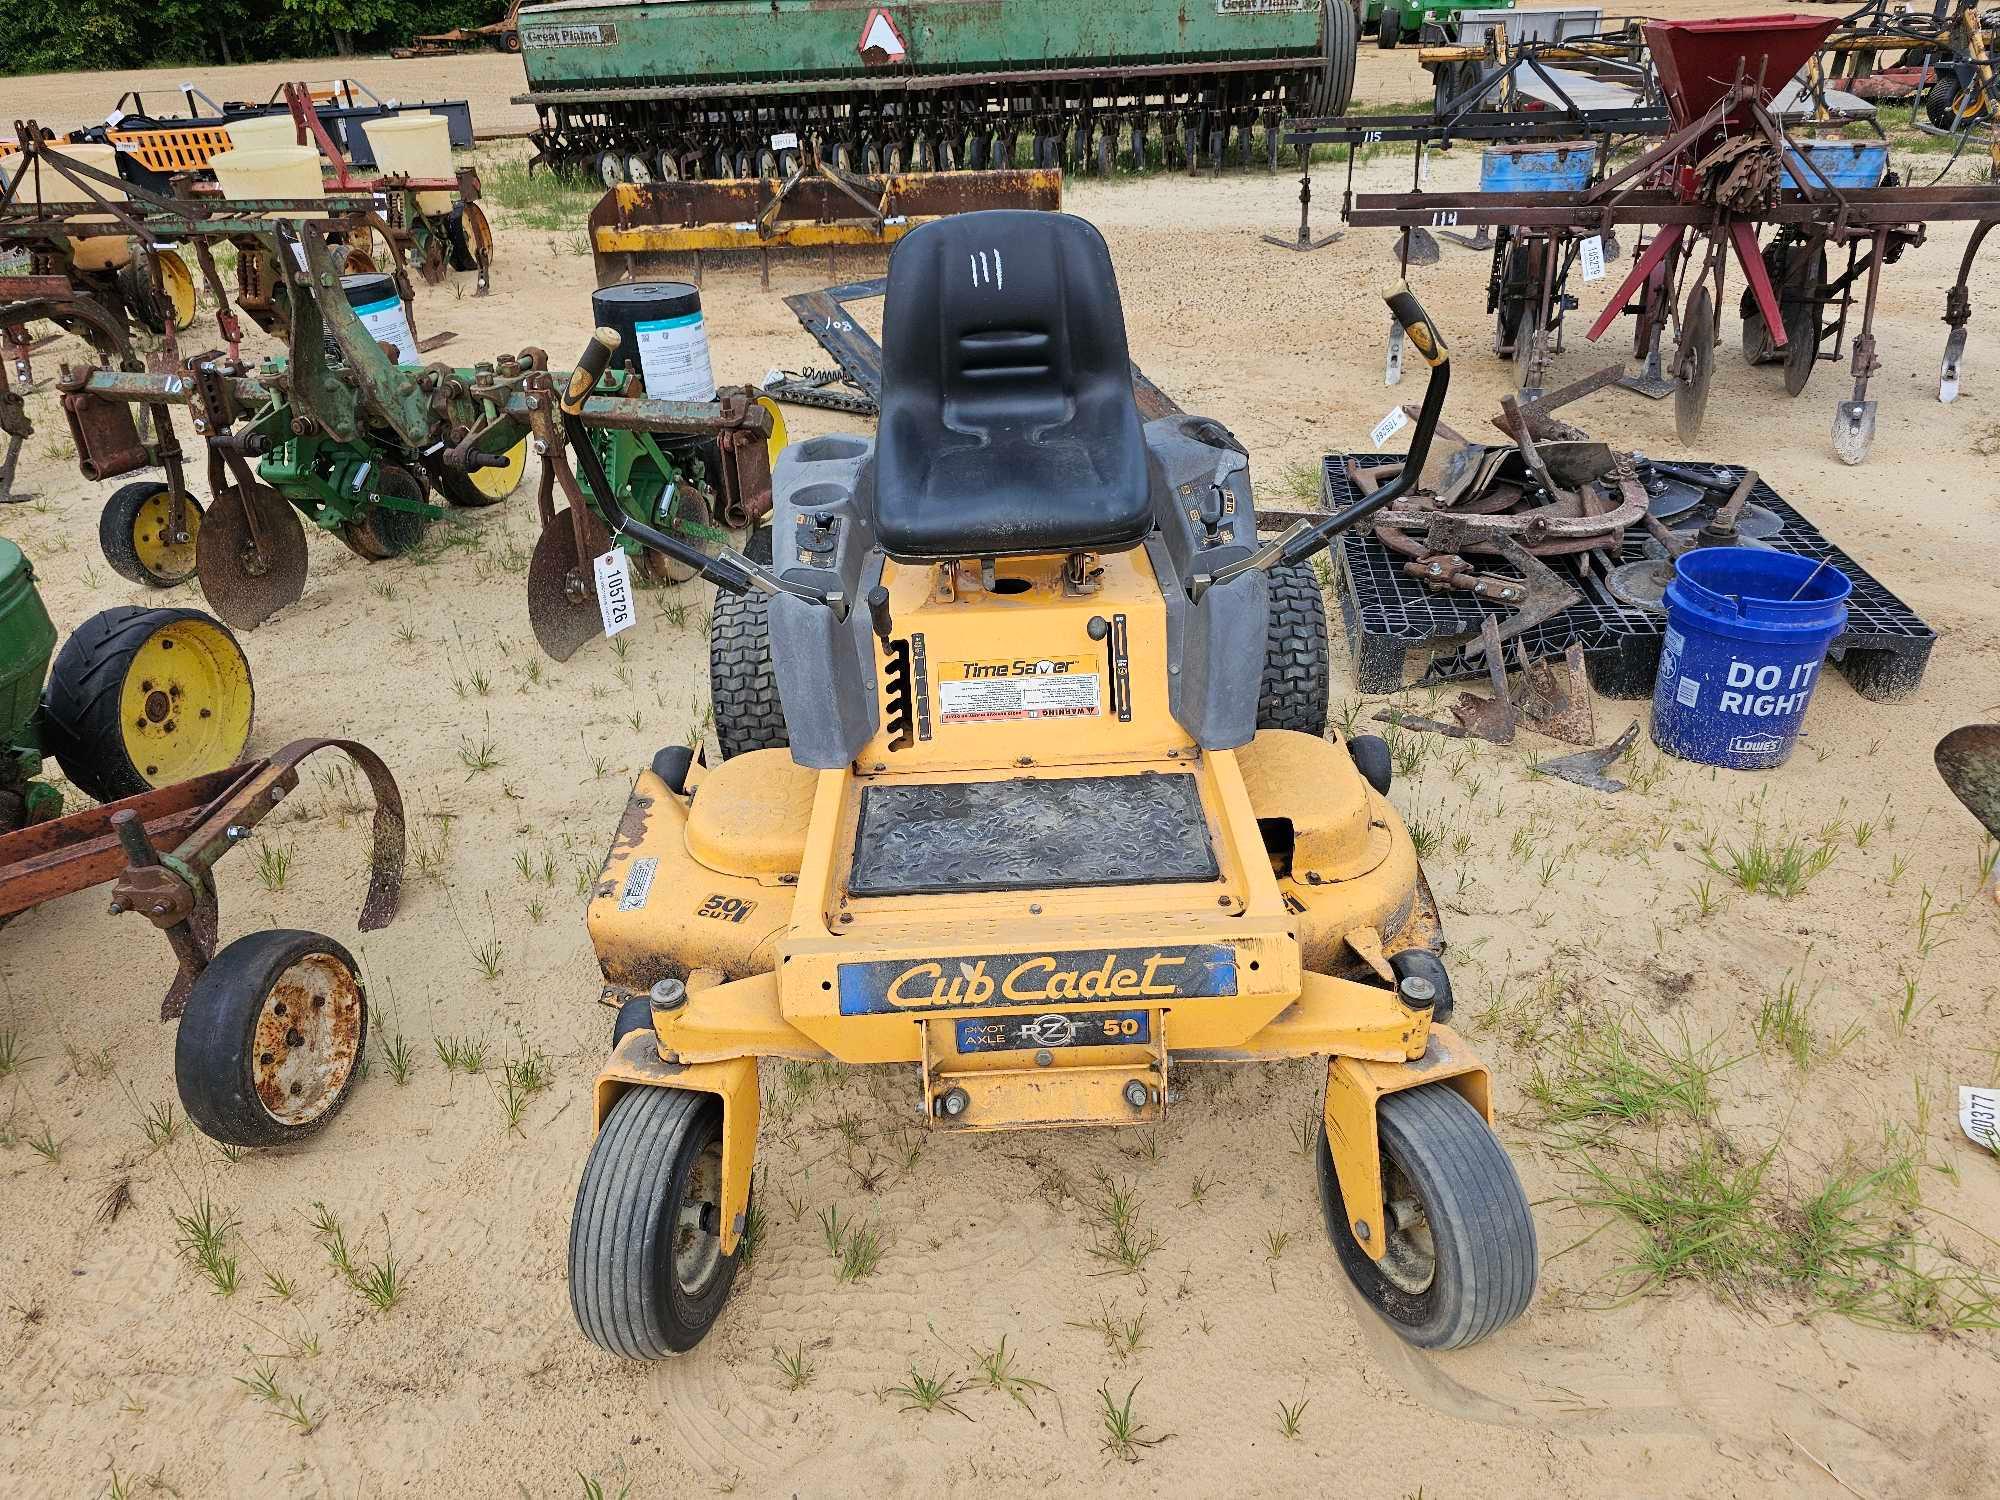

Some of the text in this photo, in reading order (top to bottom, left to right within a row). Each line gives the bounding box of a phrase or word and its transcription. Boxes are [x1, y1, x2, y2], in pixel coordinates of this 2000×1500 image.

[527, 30, 598, 43] Great Plains
[1364, 131, 1382, 143] 115
[1432, 211, 1458, 226] 114
[825, 316, 852, 332] 108
[607, 569, 628, 624] 105726
[963, 662, 1009, 679] Time
[1726, 660, 1819, 691] DO IT
[1719, 690, 1809, 717] RIGHT
[1042, 707, 1085, 717] WARNING
[697, 909, 733, 921] CUT
[887, 952, 1187, 1008] Cub Cadet
[964, 1024, 1006, 1035] PIVOT
[1102, 1018, 1139, 1036] 50
[964, 1035, 1006, 1045] AXLE
